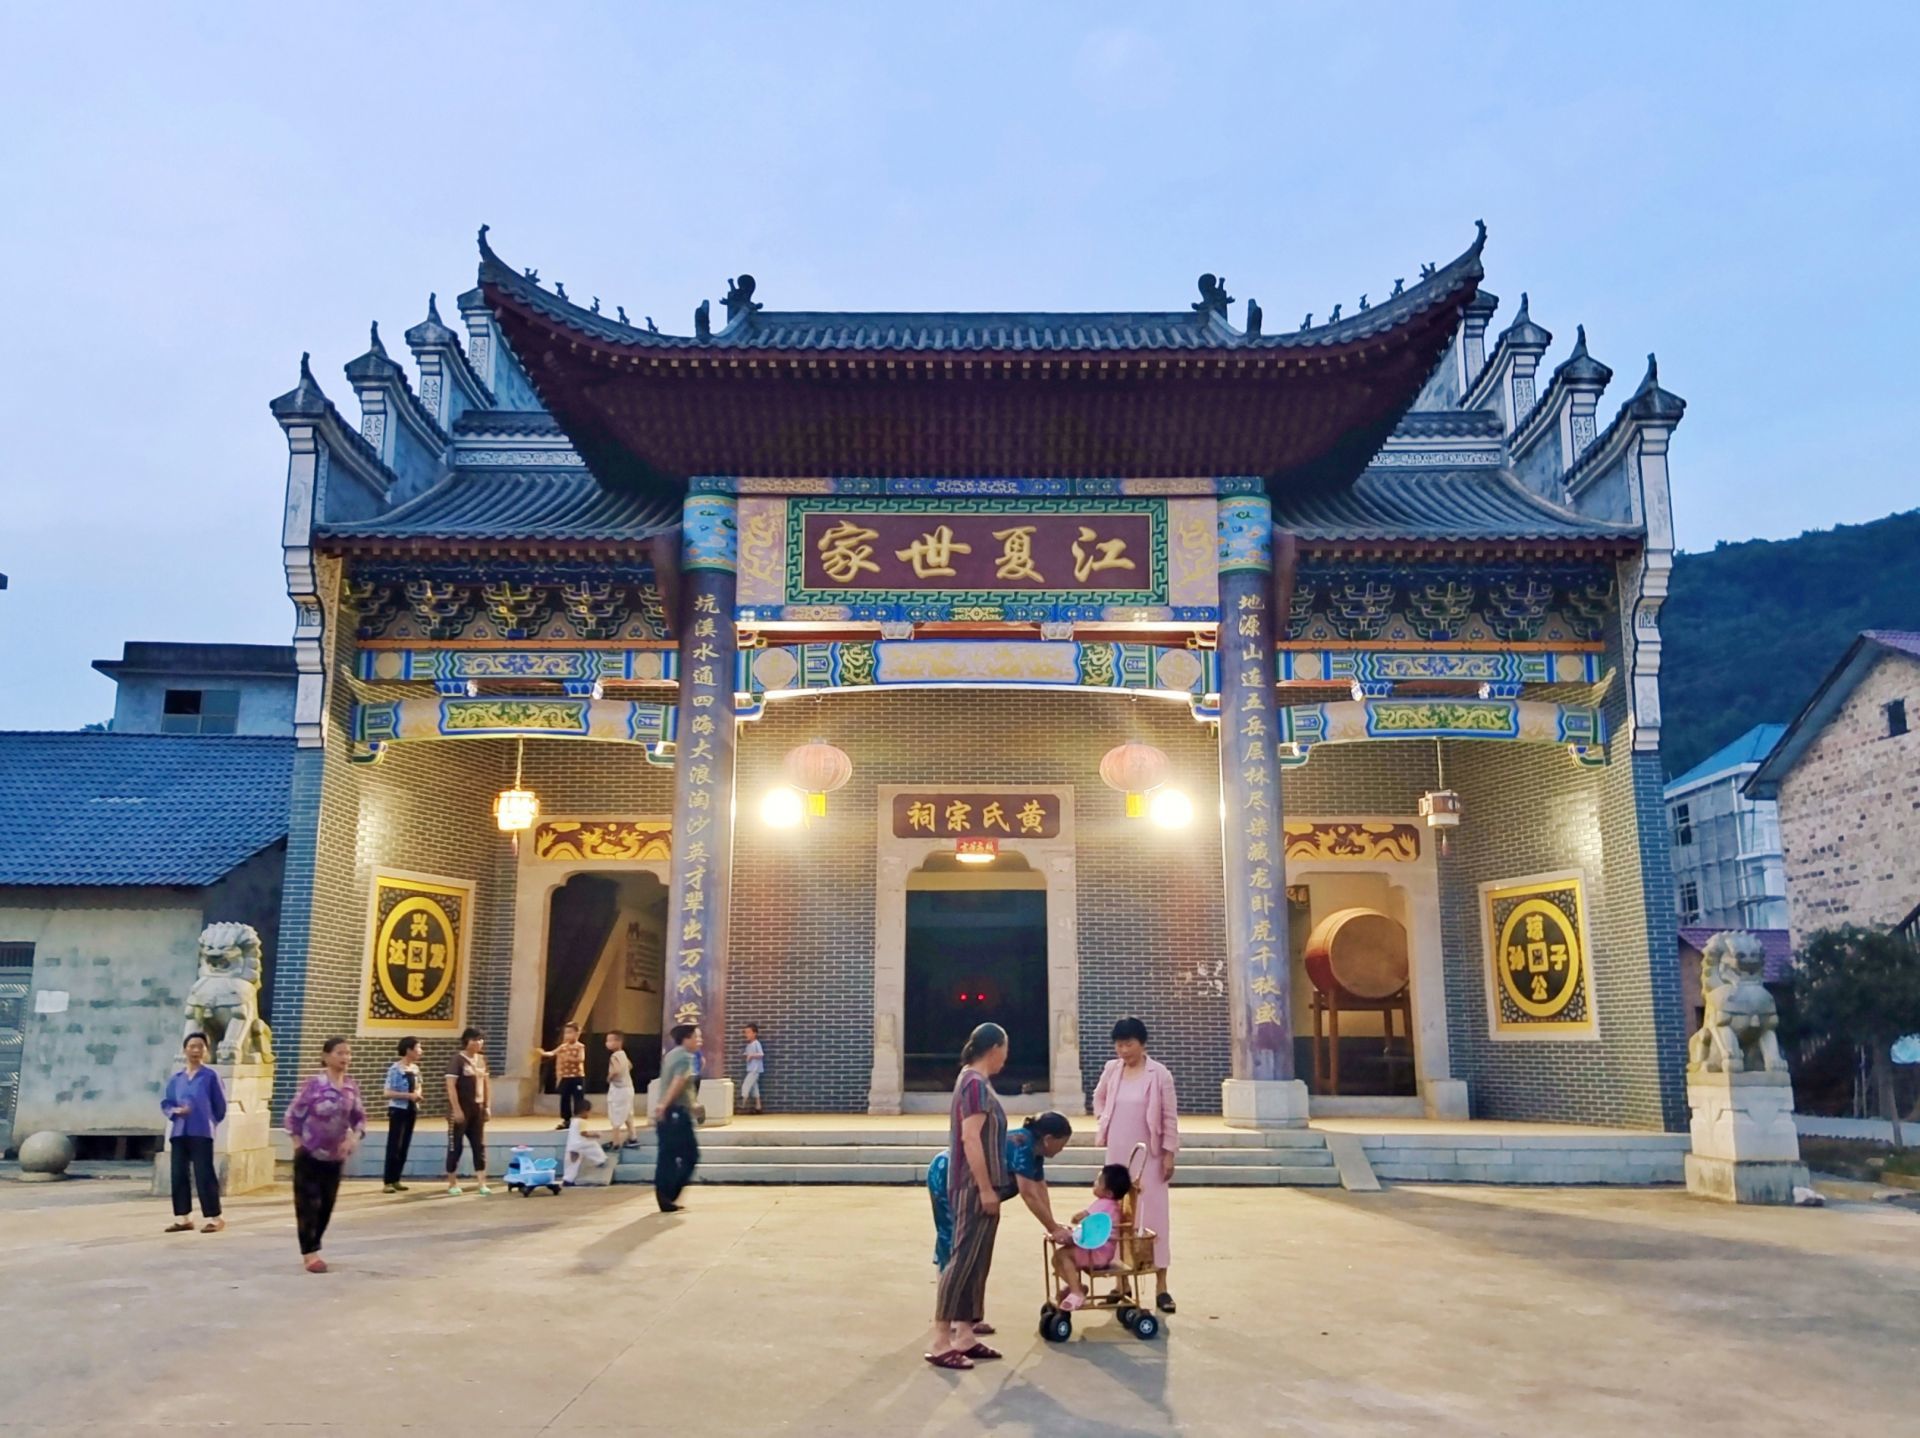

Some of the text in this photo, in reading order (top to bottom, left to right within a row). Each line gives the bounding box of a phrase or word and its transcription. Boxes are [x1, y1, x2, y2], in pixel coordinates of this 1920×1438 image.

[818, 520, 1136, 583] 江夏世家
[906, 799, 1046, 833] 黄氏宗祠
